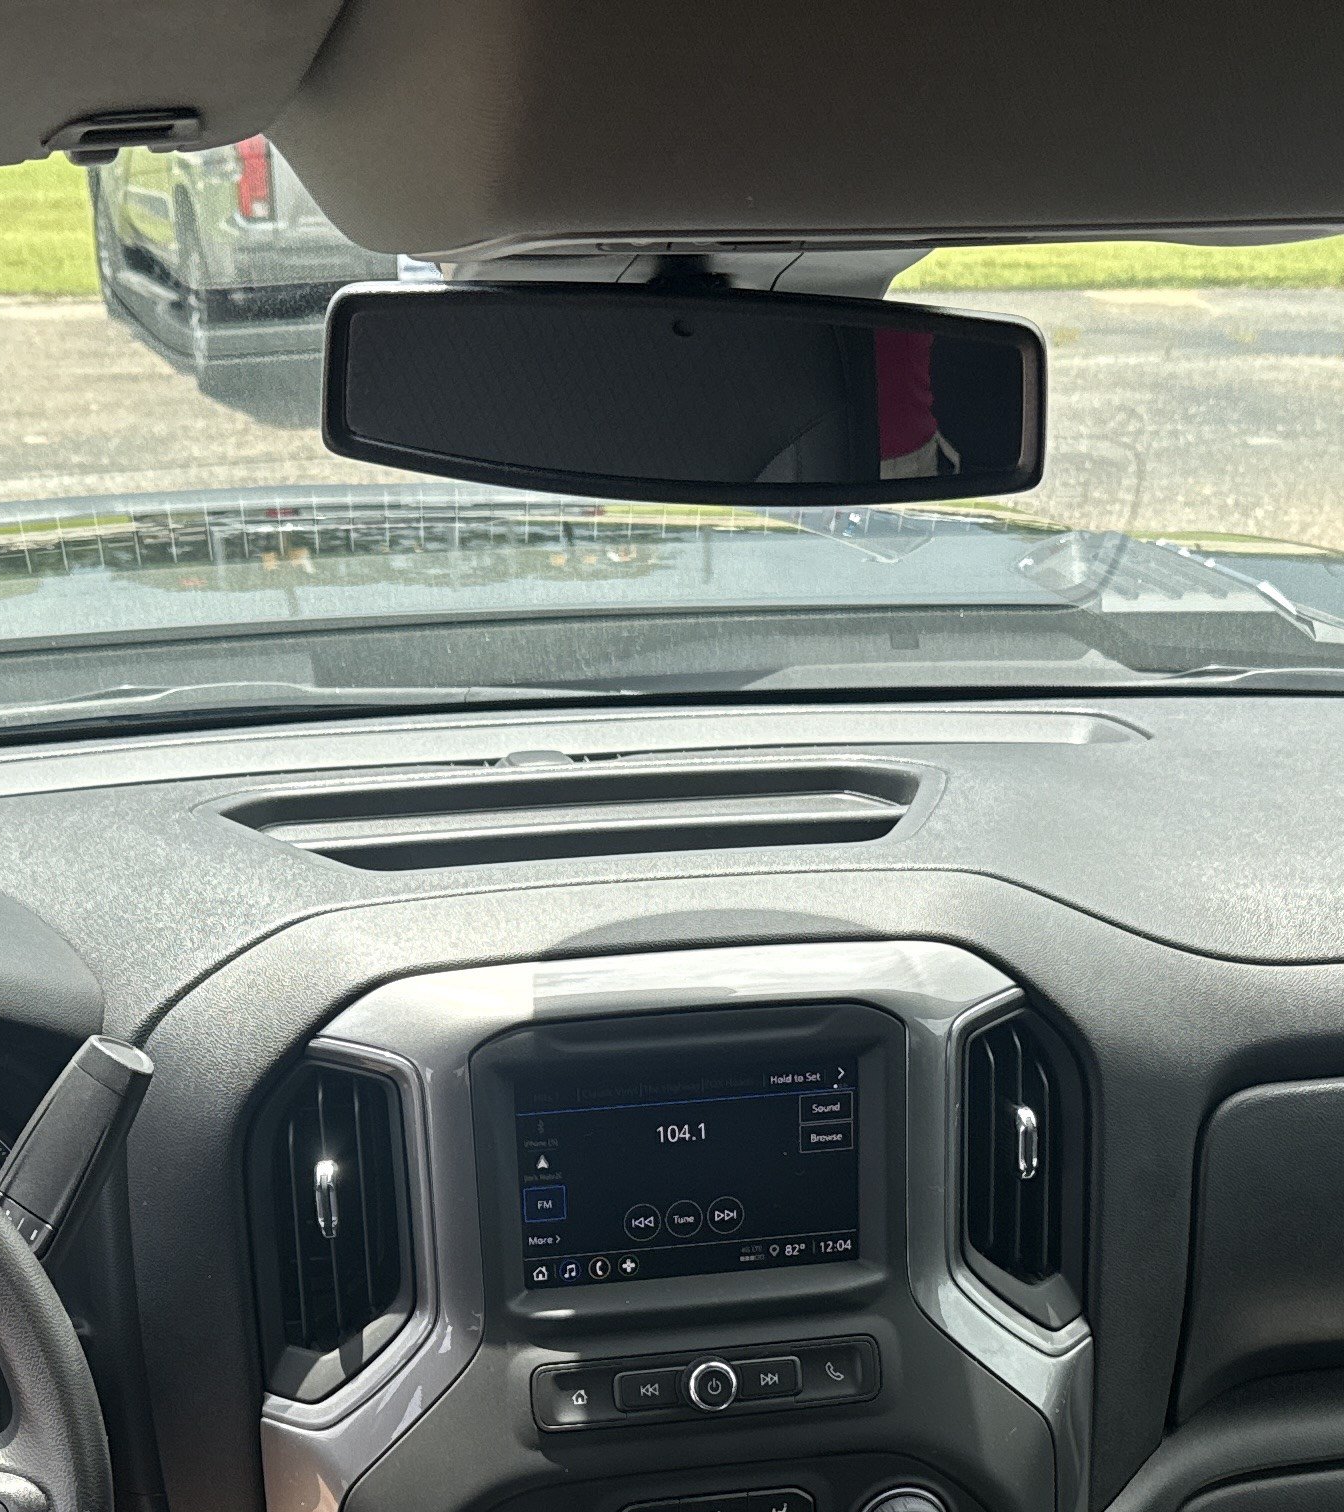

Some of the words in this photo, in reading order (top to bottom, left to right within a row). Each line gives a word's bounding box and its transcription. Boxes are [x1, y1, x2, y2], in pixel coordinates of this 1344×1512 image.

[770, 1073, 793, 1085] Hold
[794, 1074, 804, 1083] to
[805, 1072, 821, 1082] Set
[811, 1102, 841, 1114] Sound
[656, 1122, 707, 1143] 104.1
[810, 1132, 843, 1143] Browse
[537, 1199, 553, 1210] FM
[672, 1214, 695, 1225] Tune
[528, 1235, 553, 1246] More
[820, 1239, 852, 1253] 12:04
[784, 1243, 806, 1256] 82°
